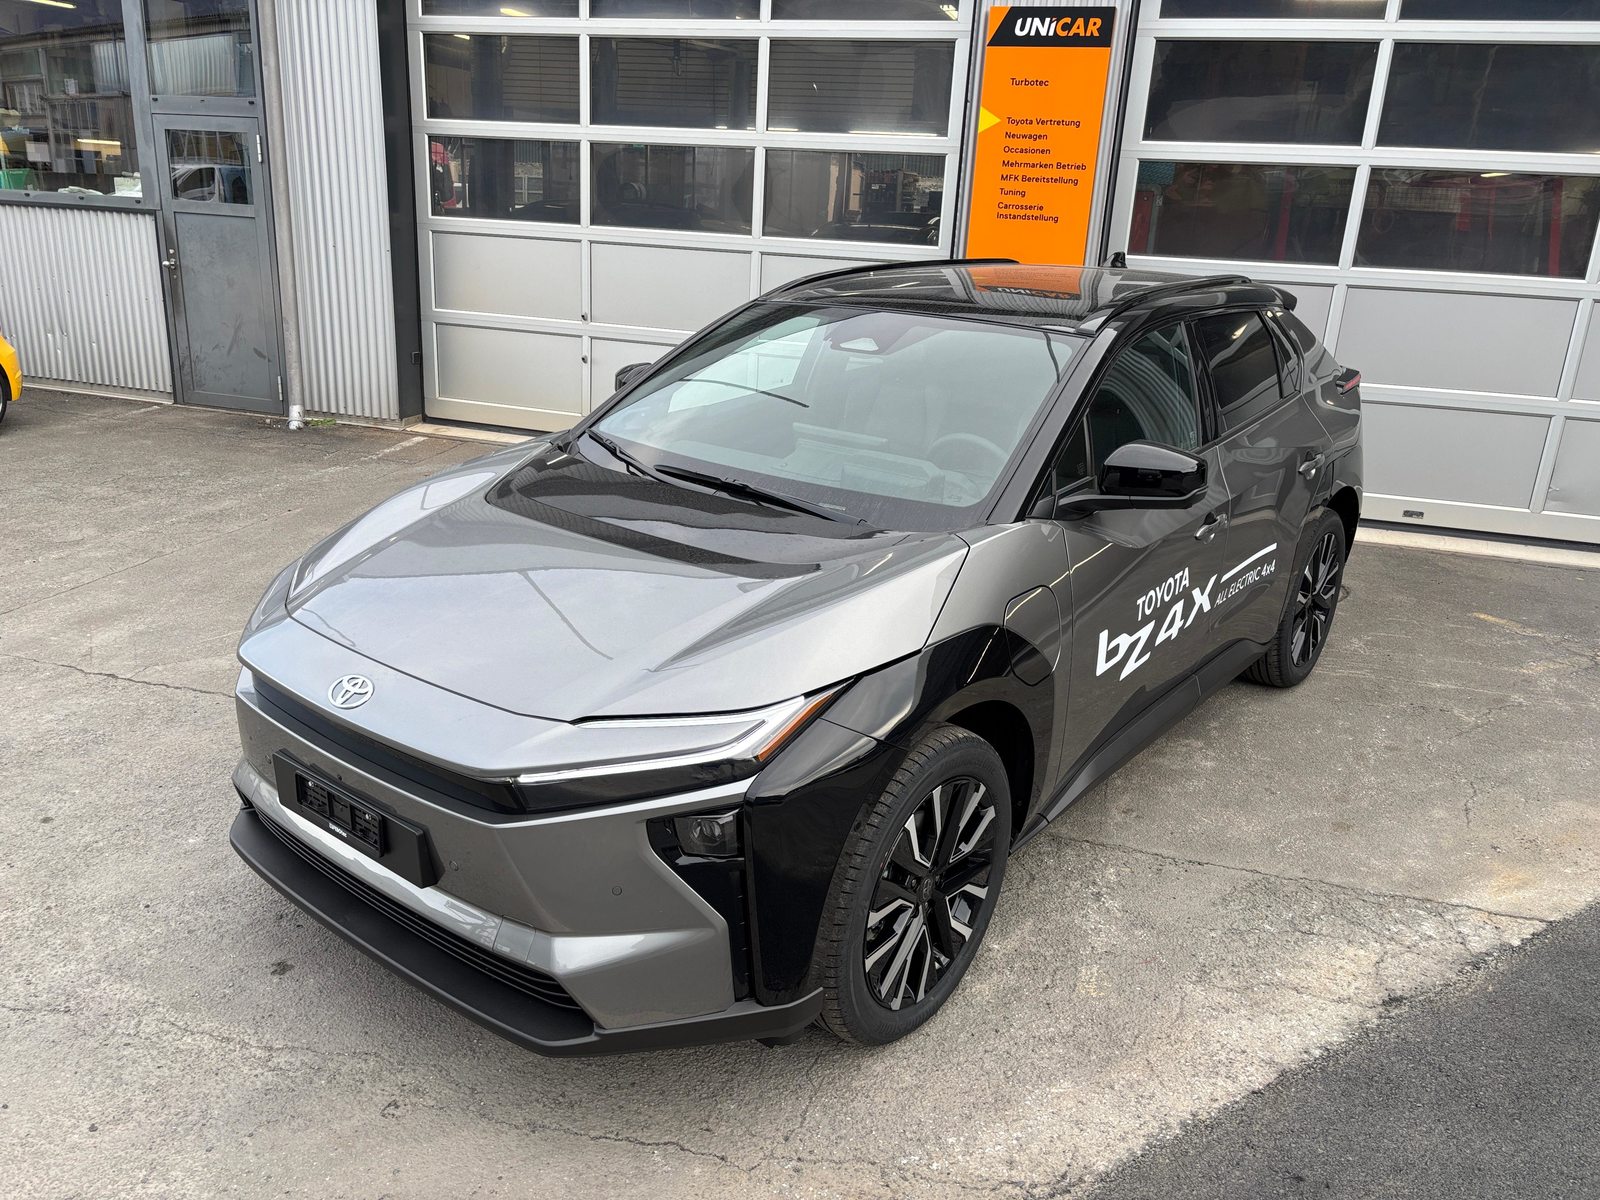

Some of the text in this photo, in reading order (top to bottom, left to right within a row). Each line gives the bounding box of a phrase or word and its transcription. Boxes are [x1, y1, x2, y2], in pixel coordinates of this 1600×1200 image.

[1010, 77, 1050, 87] Turbotec
[1006, 116, 1081, 128] Toyota Vertretung
[1004, 131, 1048, 141] Neuwagen
[1003, 146, 1051, 155] Occasionen
[1001, 160, 1087, 171] Mehrmarken Betrieb
[1000, 174, 1079, 186] MFK Bereitstellung
[999, 188, 1026, 198] Tuning
[997, 202, 1044, 211] Carrosserie
[996, 212, 1059, 223] Instandstellung
[1136, 567, 1190, 621] TOYOTA
[1213, 592, 1228, 608] ALL
[1228, 569, 1260, 598] ELECTRIC
